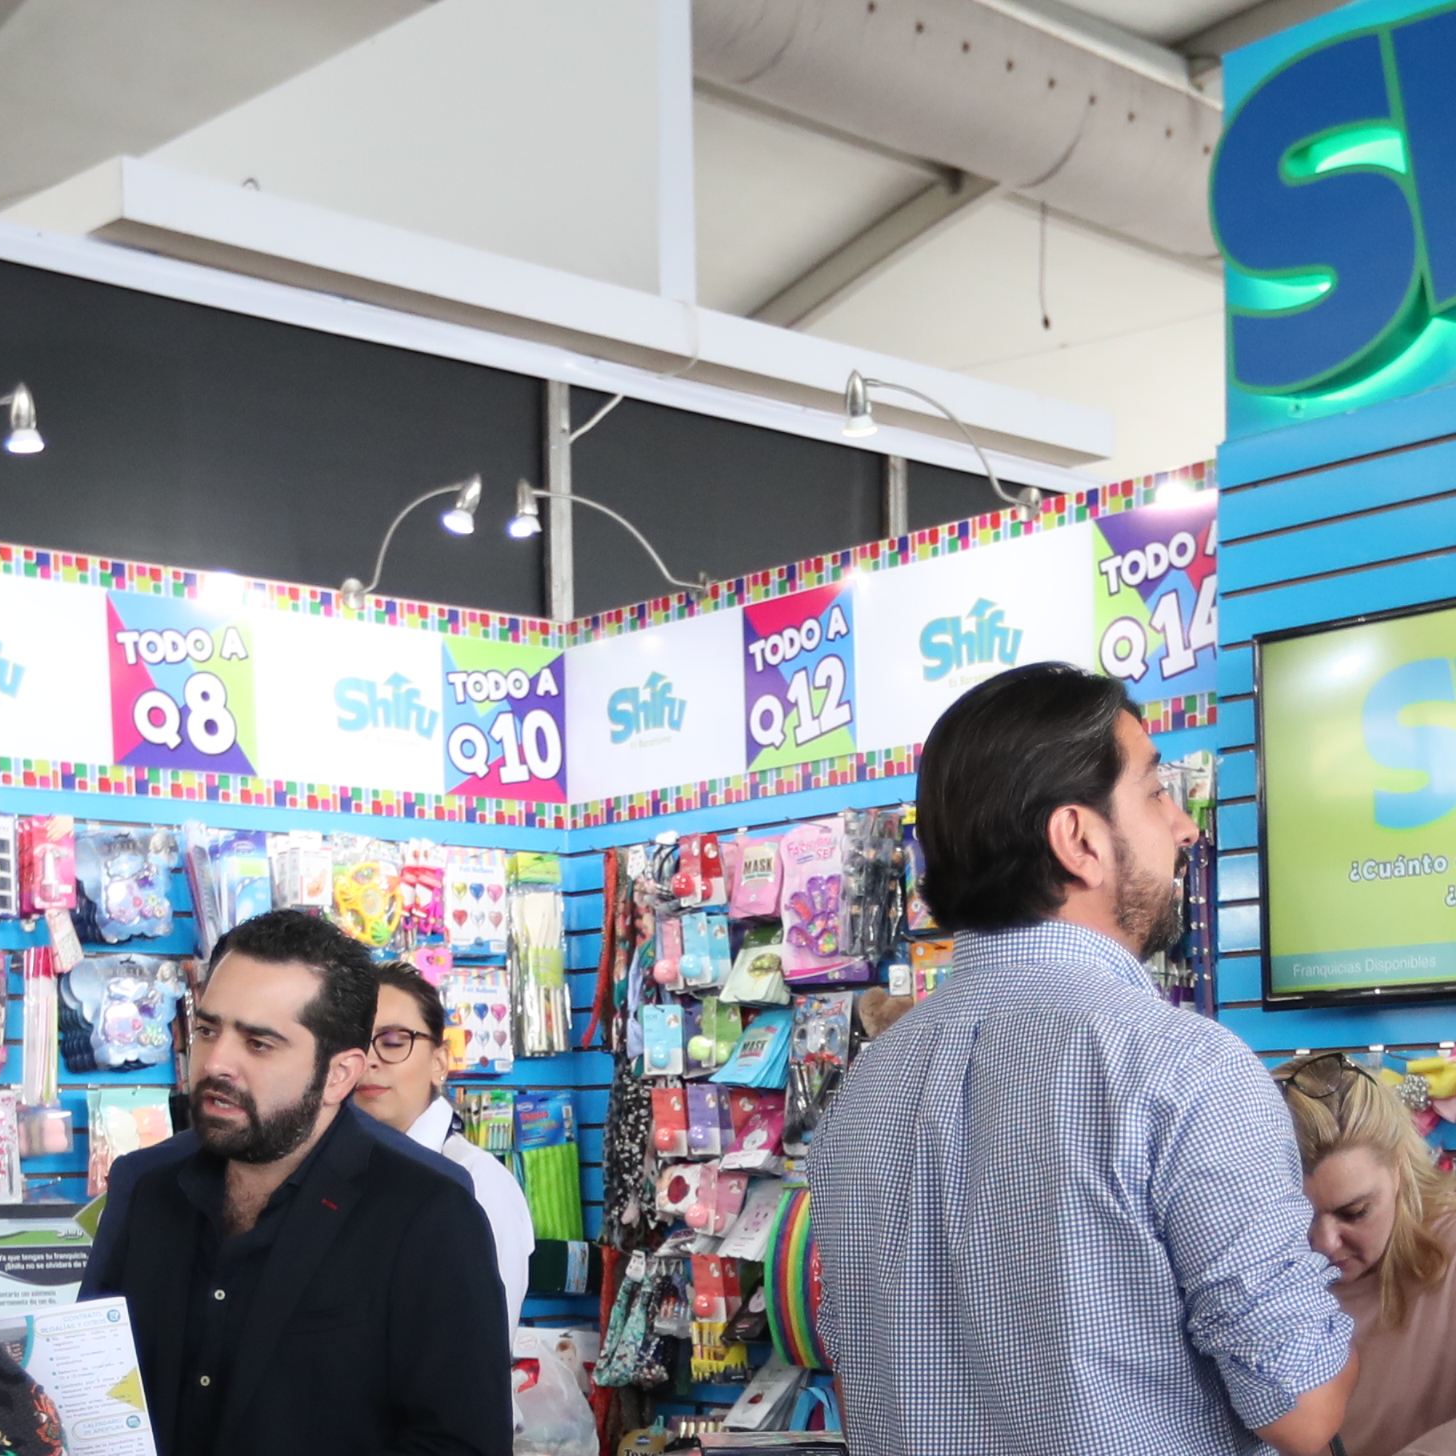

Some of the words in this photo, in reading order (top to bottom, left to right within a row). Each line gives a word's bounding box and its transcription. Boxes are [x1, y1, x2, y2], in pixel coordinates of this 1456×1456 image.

[1099, 531, 1196, 597] TODO
[115, 626, 214, 666] TODO
[219, 626, 249, 663] A
[748, 618, 822, 673] TODO
[826, 604, 849, 642] A
[919, 597, 1024, 682] Shifu
[1099, 574, 1218, 684] Q14
[132, 671, 238, 756] Q8
[333, 672, 440, 740] Shifu
[446, 668, 530, 705] TODO
[534, 666, 560, 699] A
[607, 671, 687, 745] Shifu
[749, 653, 852, 752] Q12
[446, 708, 564, 786] Q10
[743, 857, 773, 874] MASK
[1349, 854, 1448, 882] ¿Cuánto
[1293, 961, 1362, 978] Franquicias
[1365, 955, 1437, 973] Disponibles
[8, 1255, 21, 1263] que
[21, 1254, 44, 1263] tengas
